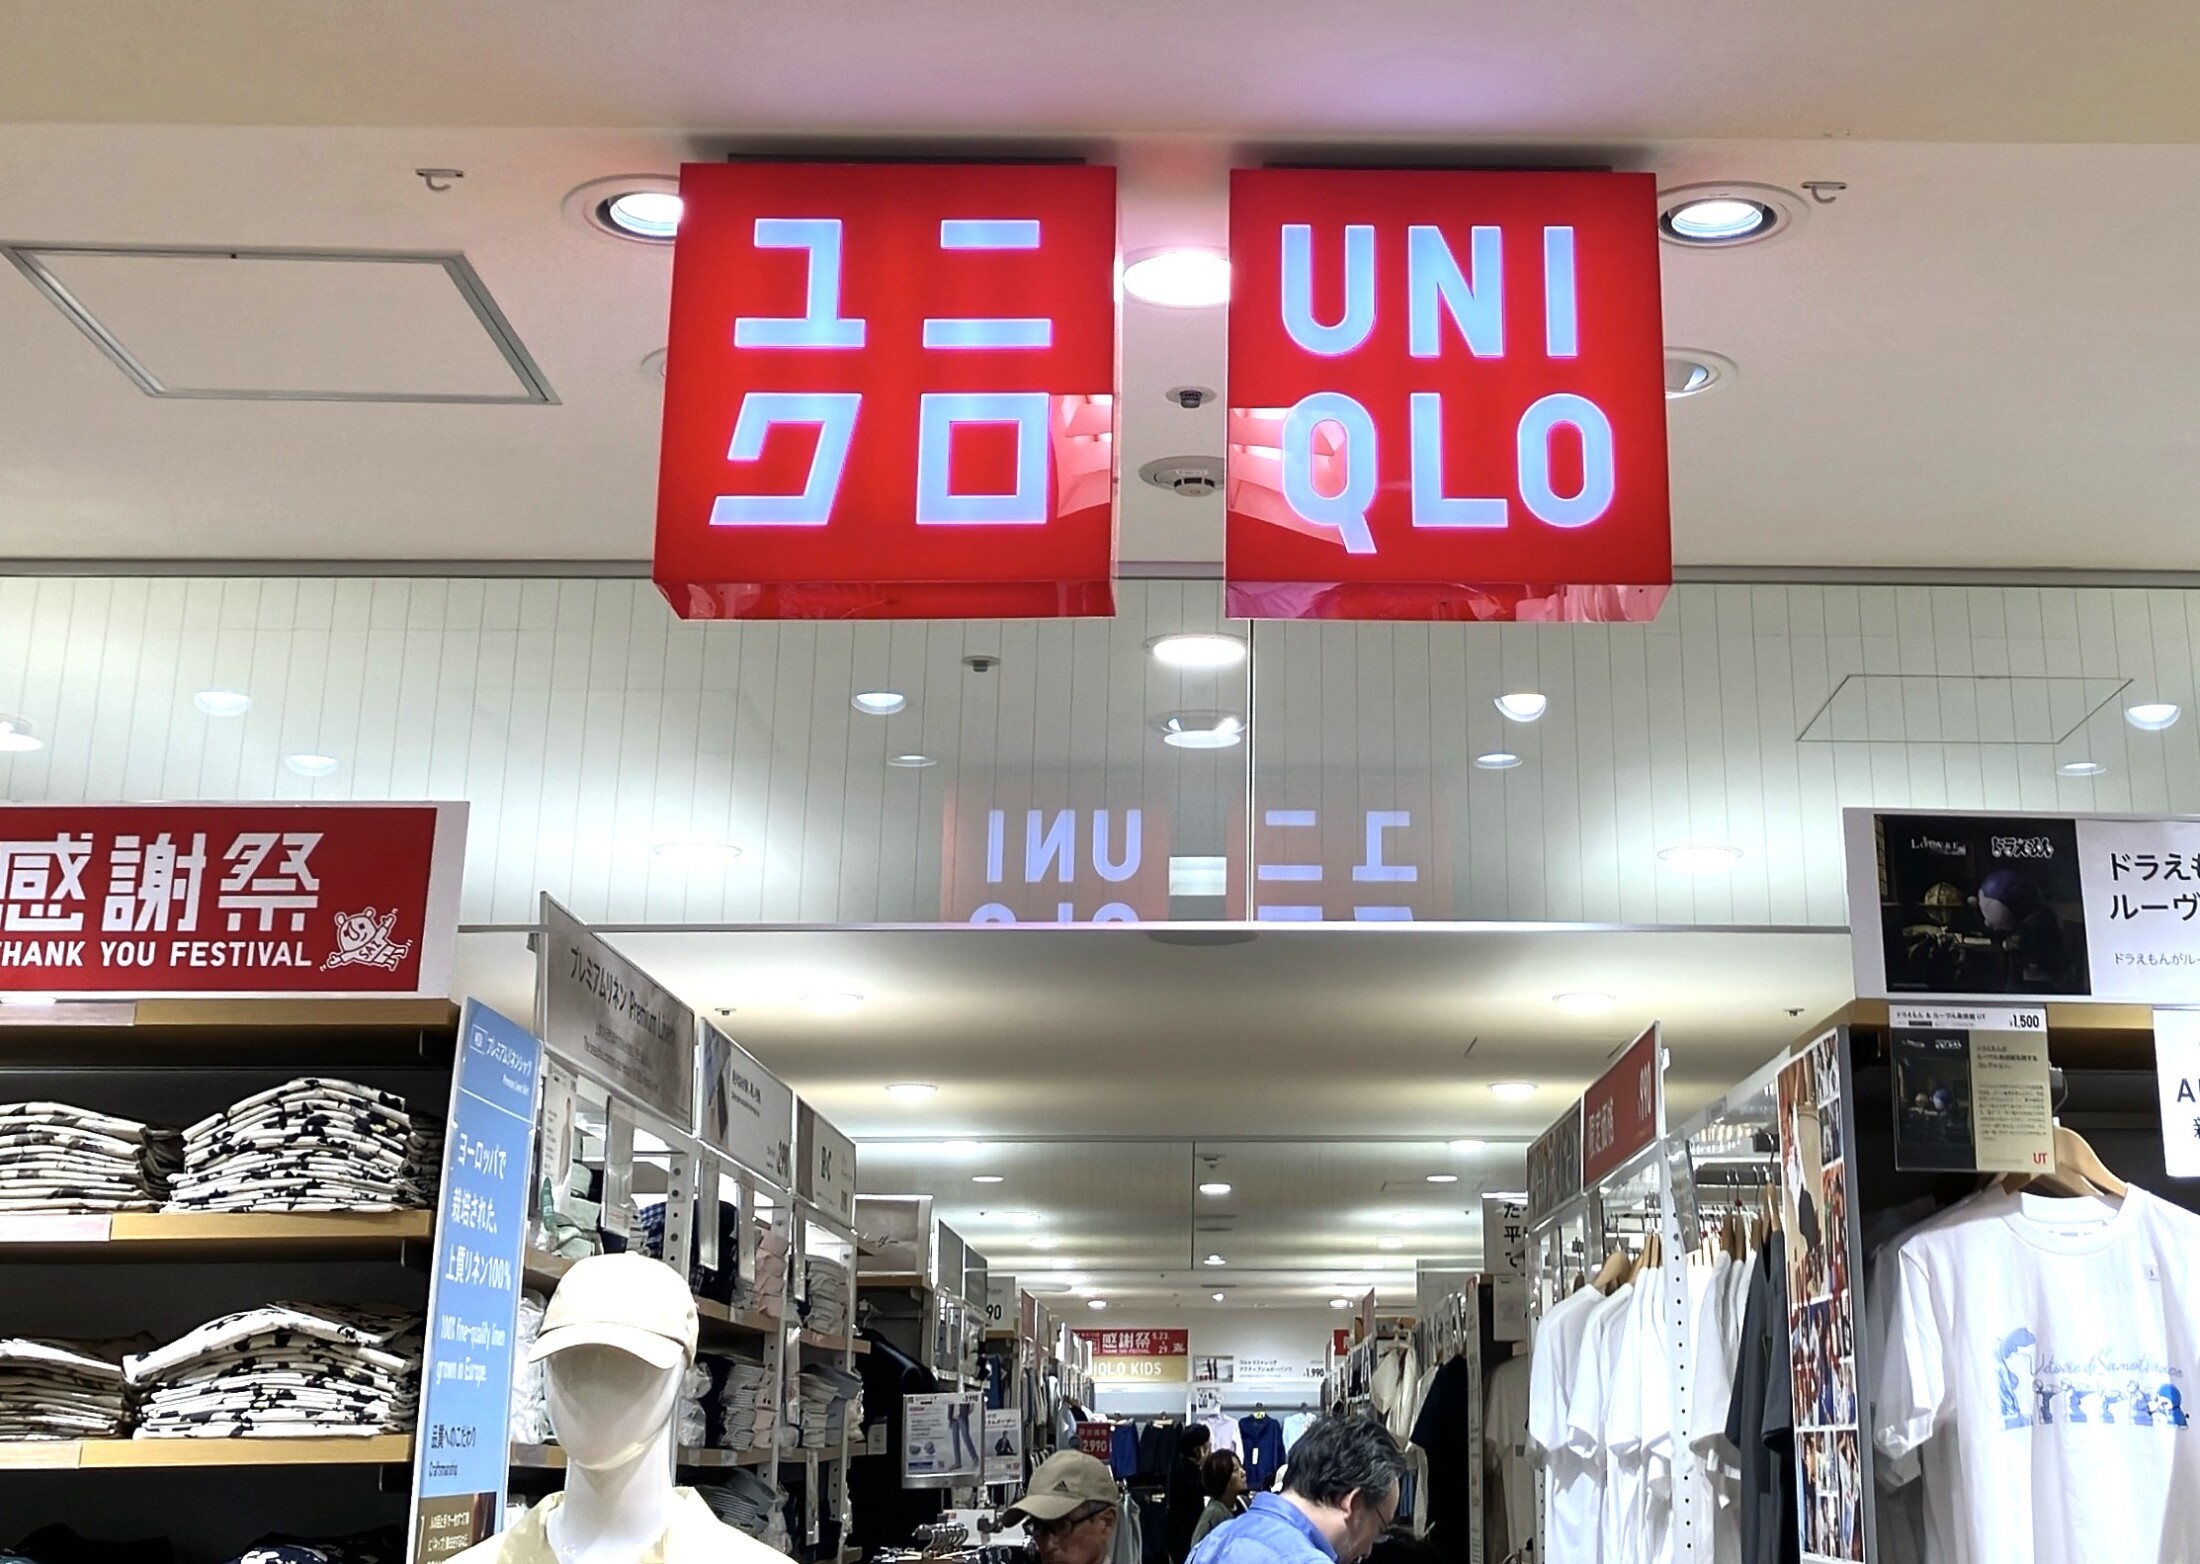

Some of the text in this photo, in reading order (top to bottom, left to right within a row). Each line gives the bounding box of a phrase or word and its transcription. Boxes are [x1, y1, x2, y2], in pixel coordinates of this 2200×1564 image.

[733, 218, 1051, 350] ユニ
[1281, 223, 1577, 358] UNI
[709, 392, 1050, 527] クロ
[1281, 391, 1616, 556] QLO
[0, 832, 324, 932] 感謝祭
[0, 940, 312, 967] HANK YOU FESTIVAL
[359, 940, 382, 960] SAI
[570, 946, 627, 1011] プレミアムリネン
[458, 1133, 507, 1180] ヨーロッパで
[2033, 1153, 2047, 1165] UT
[1131, 1361, 1162, 1375] KIDS
